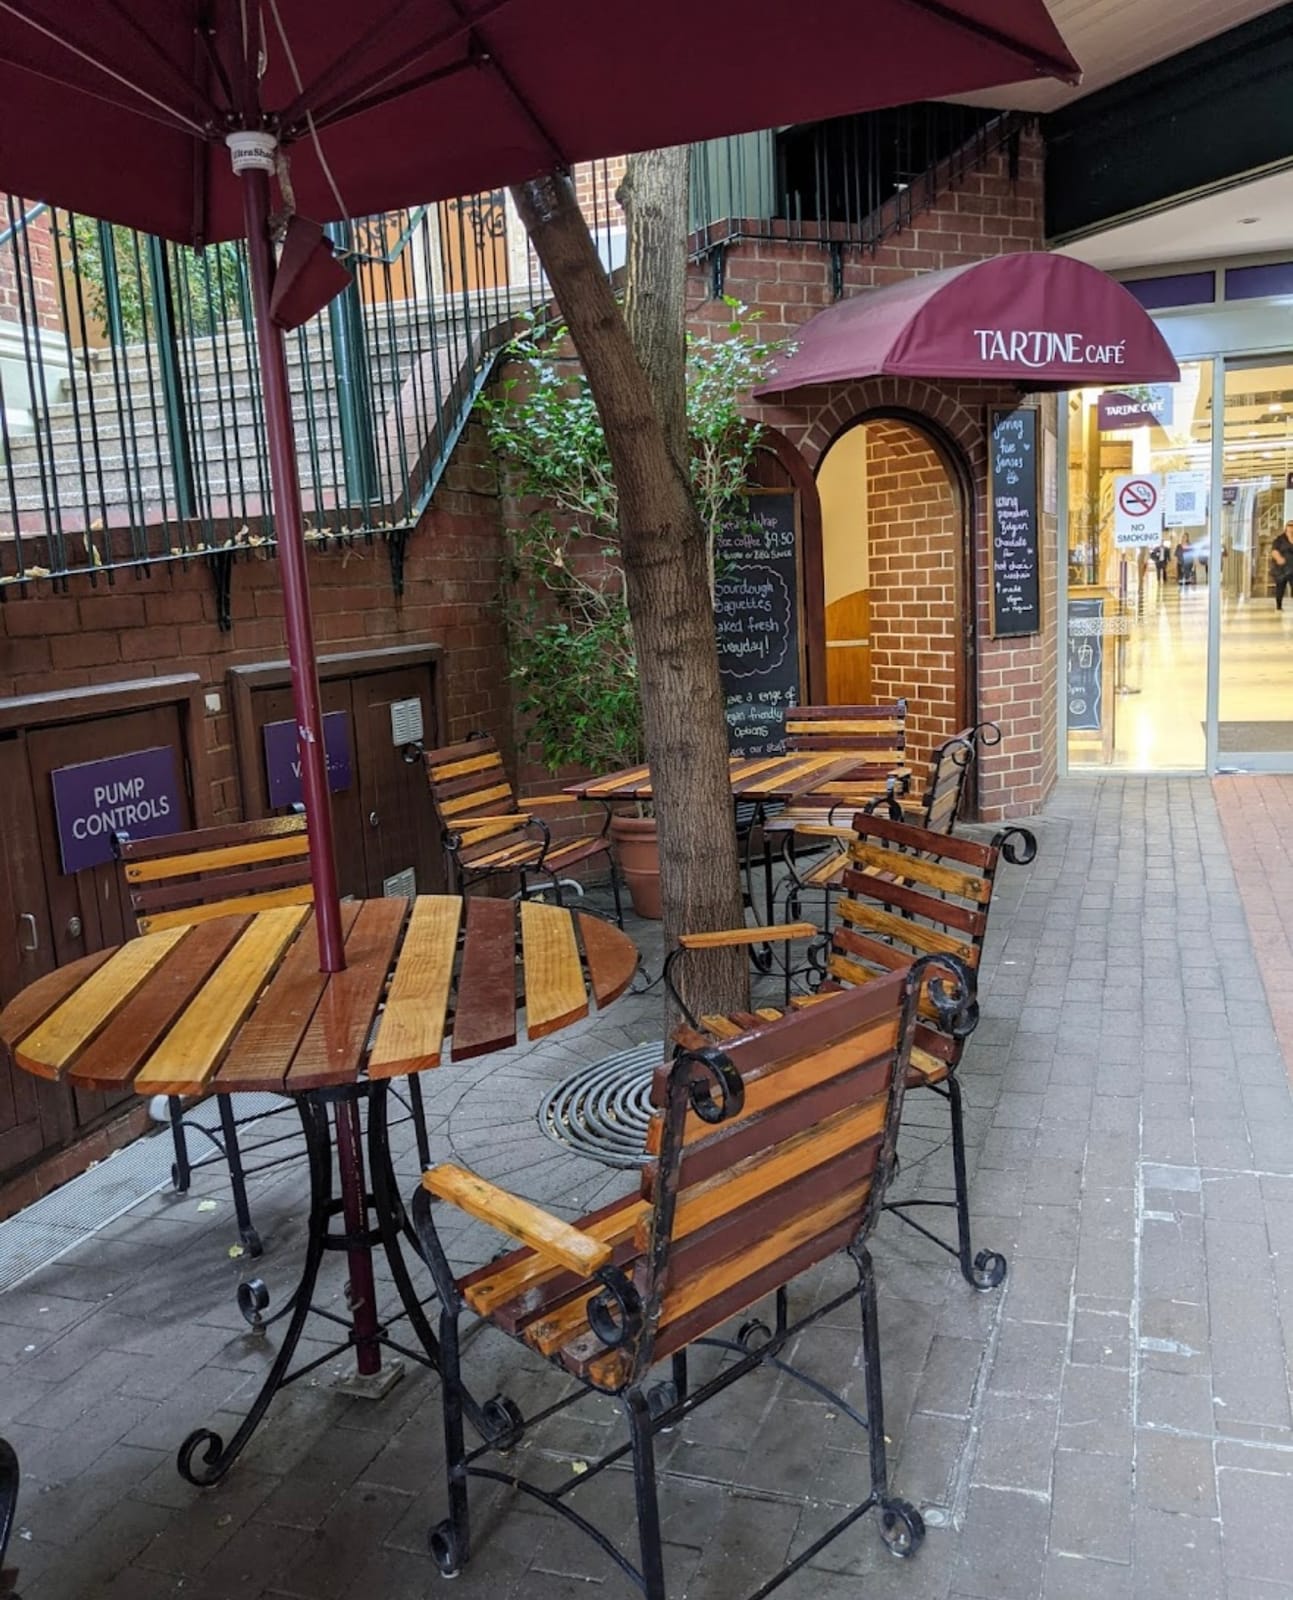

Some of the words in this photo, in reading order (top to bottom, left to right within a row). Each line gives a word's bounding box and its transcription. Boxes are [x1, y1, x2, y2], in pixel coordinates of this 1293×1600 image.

[973, 329, 1084, 368] TARTINE
[1085, 339, 1126, 364] CAFÉ
[1104, 403, 1141, 416] TARTINE
[1130, 523, 1145, 532] NO
[734, 534, 762, 549] coffee
[1117, 532, 1159, 543] SMOKING
[718, 618, 743, 633] aked
[747, 616, 780, 633] fresh
[727, 693, 744, 705] ave
[785, 685, 797, 700] of
[724, 710, 746, 727] egan
[747, 706, 784, 723] friendly
[749, 744, 764, 754] our
[94, 777, 145, 808] PUMP
[72, 795, 171, 840] CONTROLS
